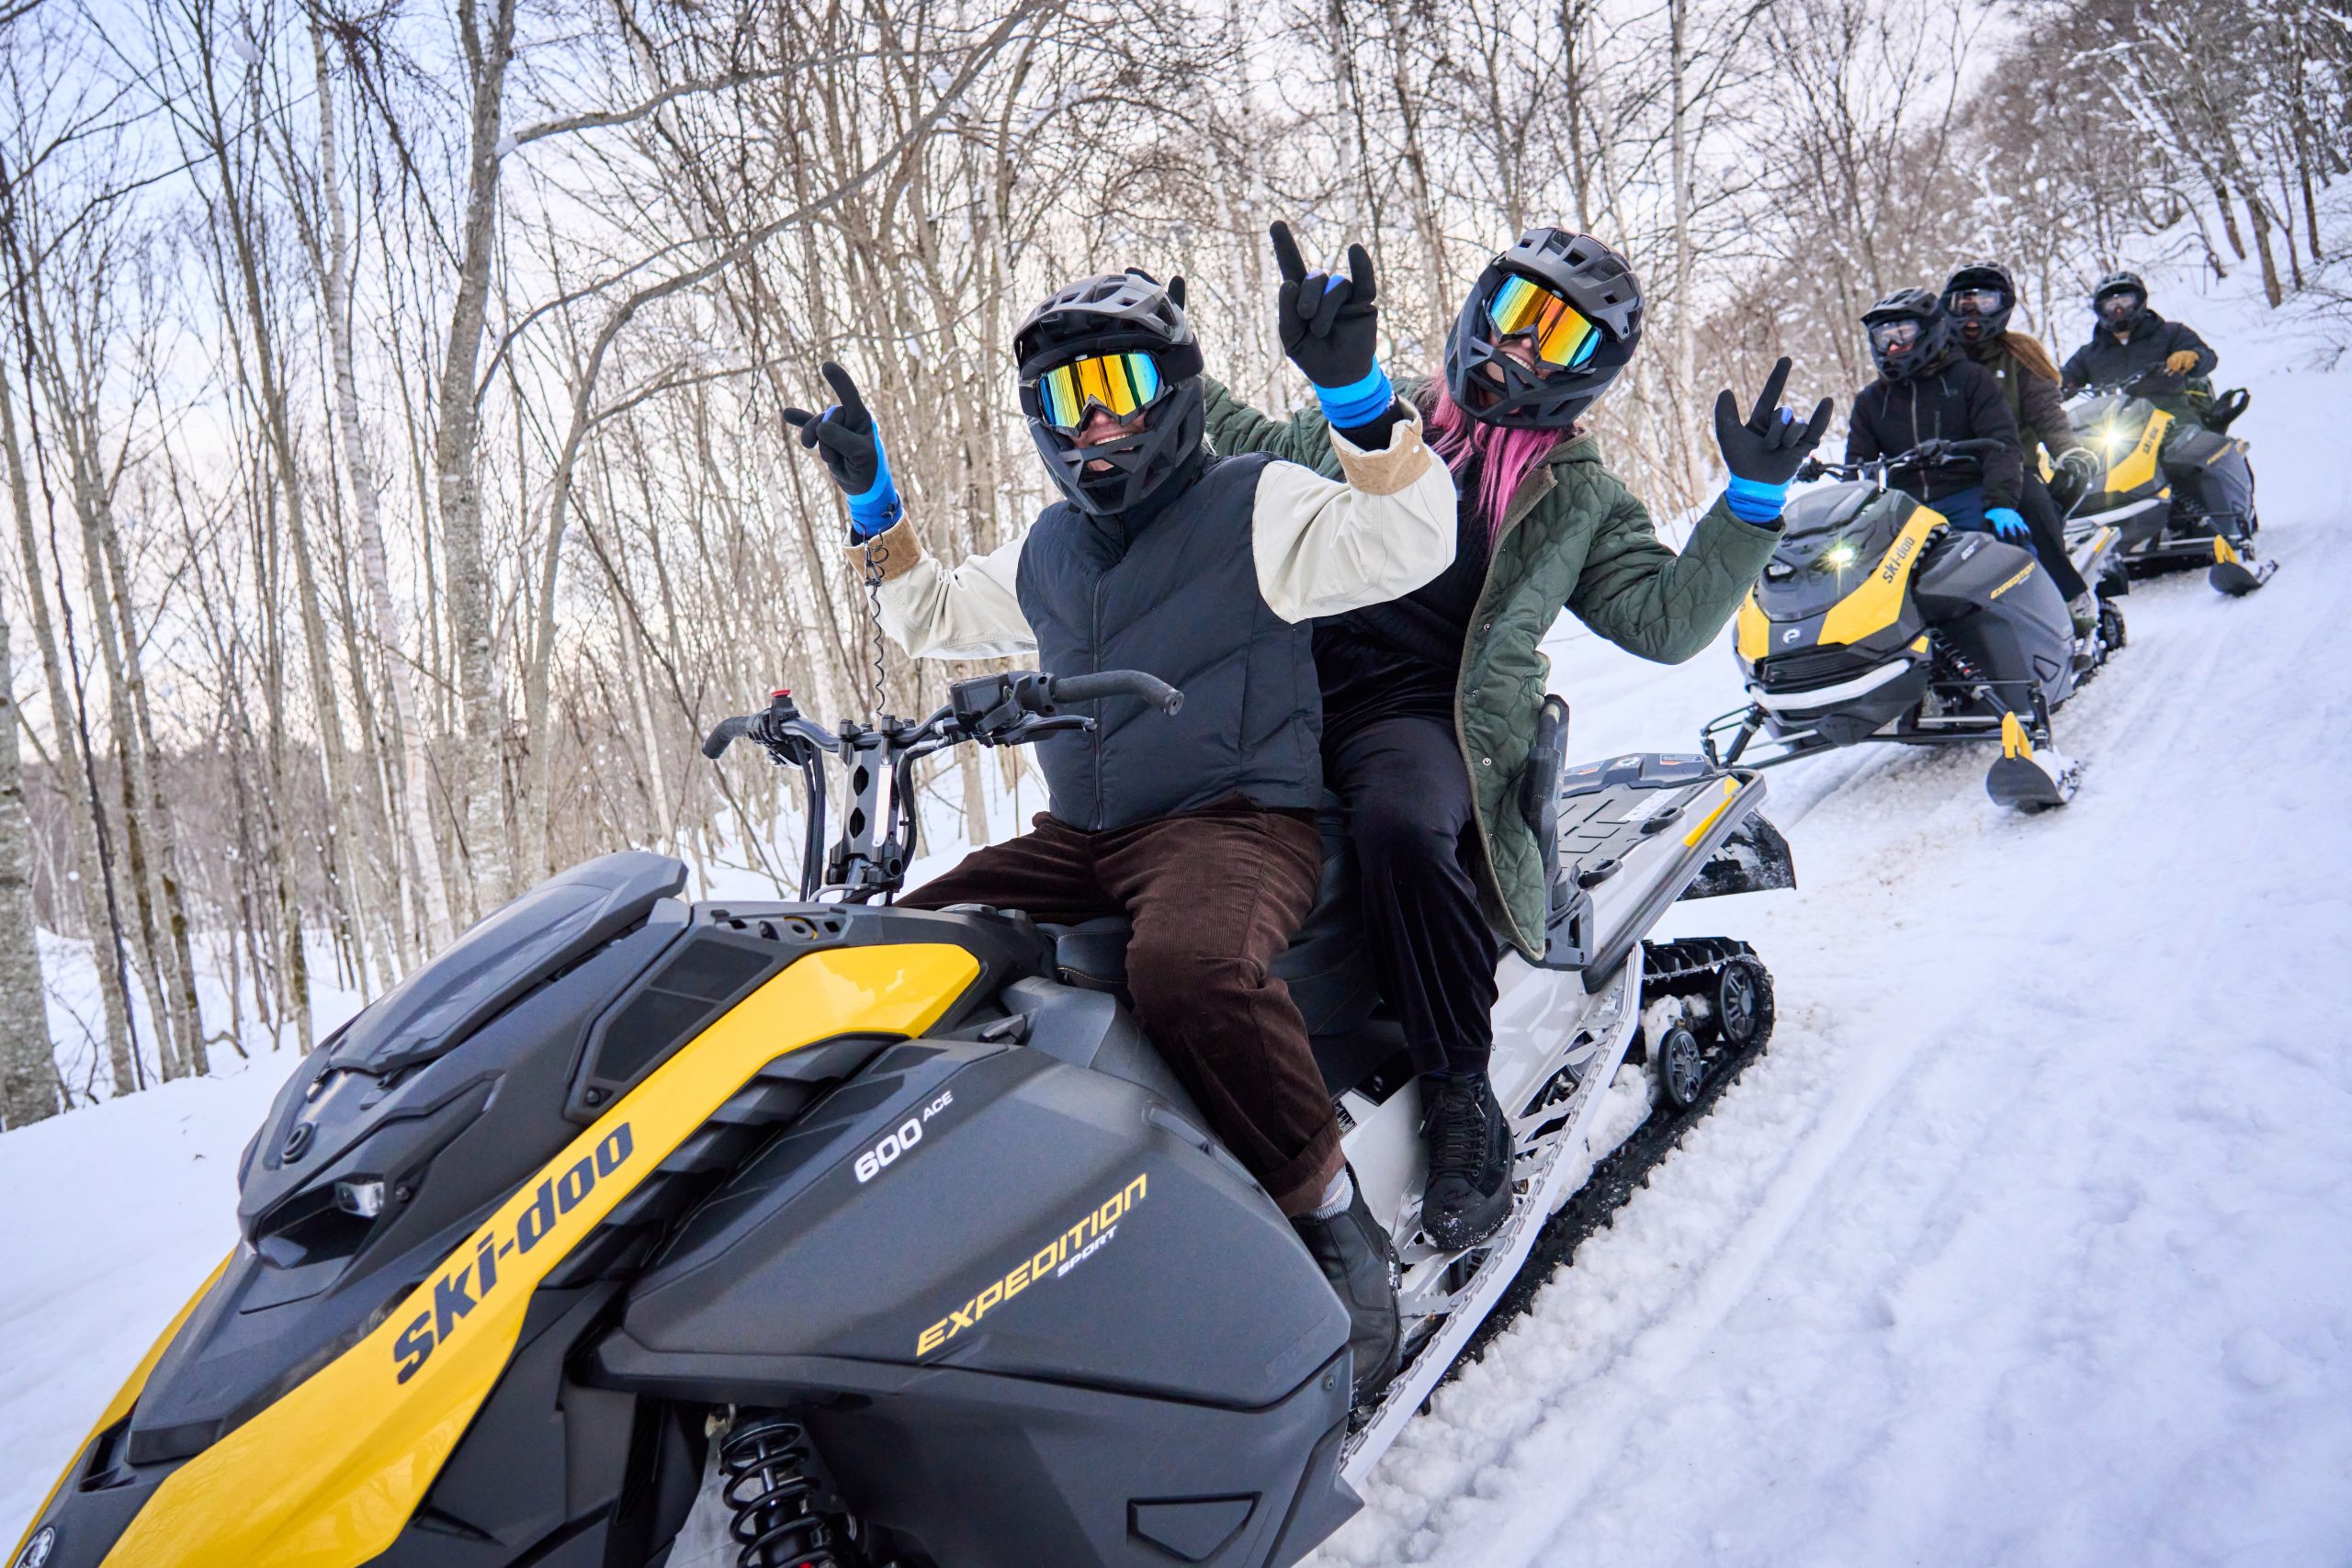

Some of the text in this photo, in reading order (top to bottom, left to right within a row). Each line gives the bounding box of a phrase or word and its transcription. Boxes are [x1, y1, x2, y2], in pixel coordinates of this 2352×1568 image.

[854, 1090, 954, 1183] 600 ACE
[916, 1173, 1147, 1357] EXPEDITION
[1057, 1224, 1117, 1279] SPORT
